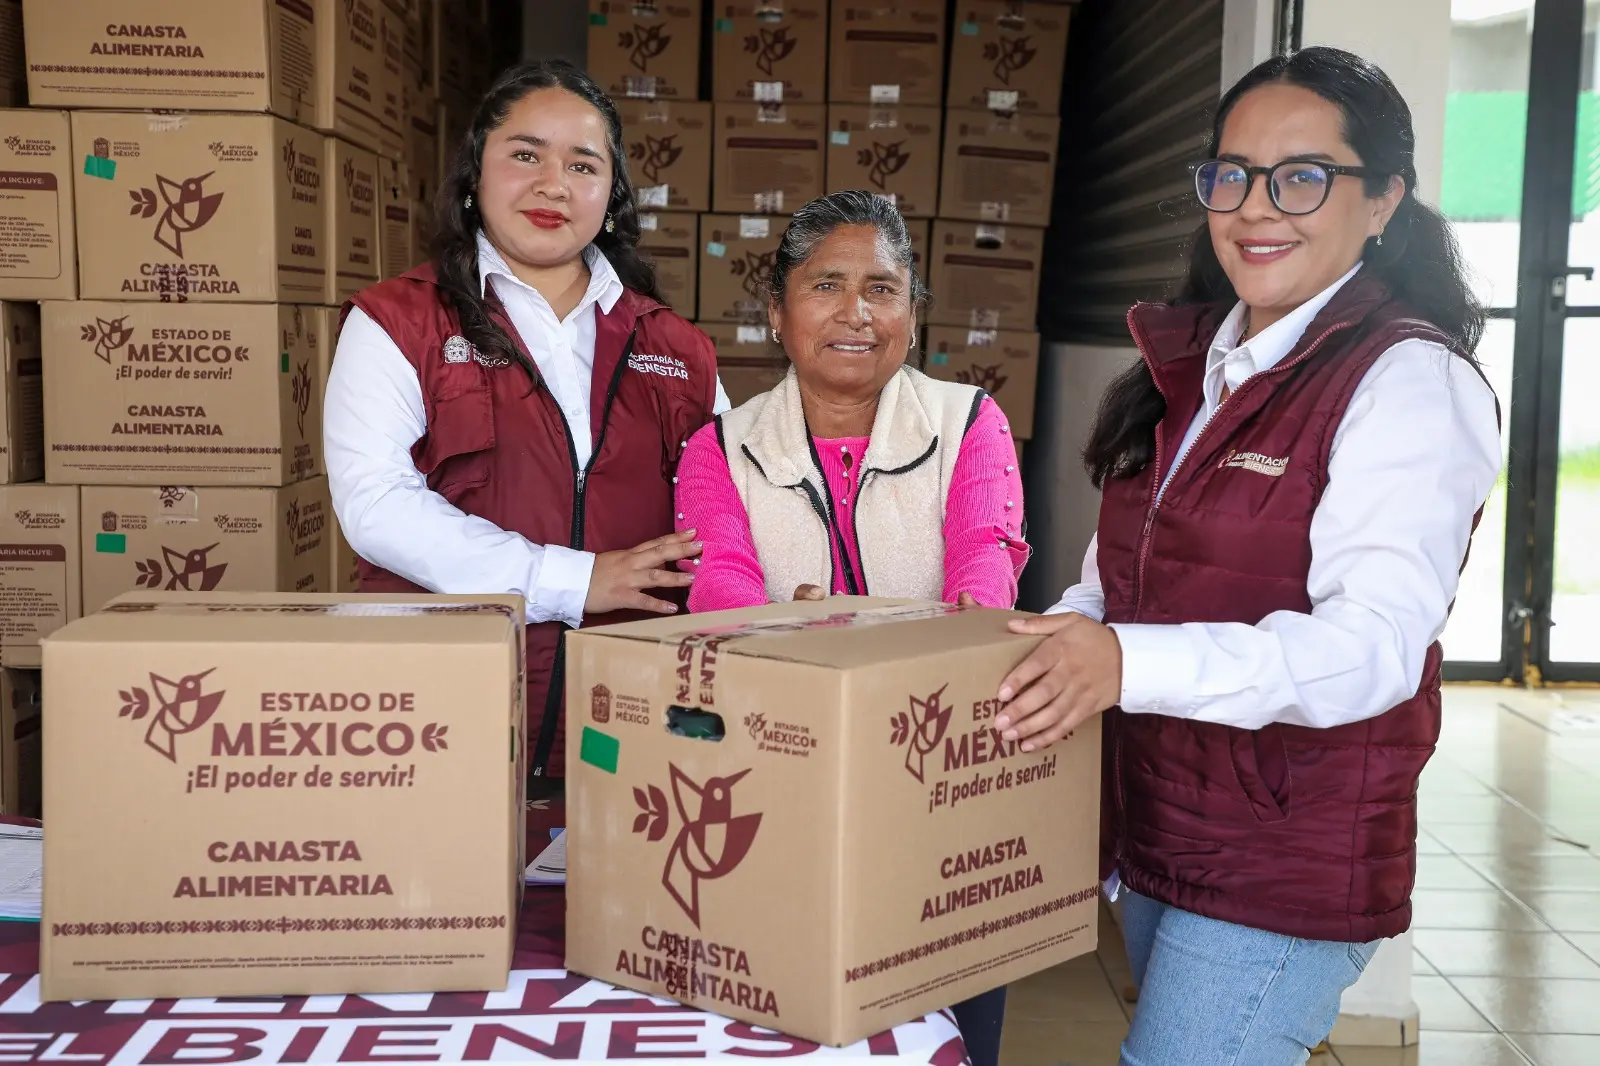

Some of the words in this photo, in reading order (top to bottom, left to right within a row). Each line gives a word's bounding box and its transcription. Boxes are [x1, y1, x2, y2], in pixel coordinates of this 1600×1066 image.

[106, 24, 187, 39] CANASTA
[90, 42, 204, 58] ALIMENTARIA
[222, 149, 253, 157] MÉXICO
[140, 263, 220, 277] CANASTA
[121, 279, 240, 294] ALIMENTARIA
[152, 328, 208, 340] ESTADO
[212, 330, 231, 341] DE
[127, 341, 232, 363] MÉXICO
[628, 352, 674, 365] CRETARÍA
[116, 365, 132, 380] ¡El
[135, 366, 172, 380] poder
[175, 366, 190, 379] de
[193, 367, 233, 380] servir!
[627, 358, 689, 380] BIENESTAR
[127, 405, 206, 418] CANASTA
[111, 422, 223, 436] ALIMENTARIA
[121, 522, 147, 530] MÉXICO
[260, 692, 371, 712] ESTADO
[378, 692, 415, 712] DE
[616, 701, 640, 712] ESTADO
[641, 706, 650, 714] DE
[615, 710, 650, 725] MÉXICO
[774, 721, 800, 732] ESTADO
[800, 726, 809, 734] DE
[210, 717, 415, 757] MÉXICO
[763, 729, 810, 748] MÉXICO
[943, 724, 1052, 772] MÉXI
[185, 764, 219, 794] ¡El
[224, 764, 298, 794] poder
[303, 764, 333, 788] de
[339, 763, 416, 788] servir!
[929, 780, 948, 814] ¡El
[951, 773, 993, 808] poder
[996, 766, 1013, 791] de
[1016, 754, 1057, 786] servir!
[207, 840, 363, 863] CANASTA
[940, 836, 1028, 880] CANASTA
[173, 873, 394, 898] ALIMENTARIA
[920, 864, 1044, 924] ALIMENTARIA
[641, 925, 752, 977] CANASTA
